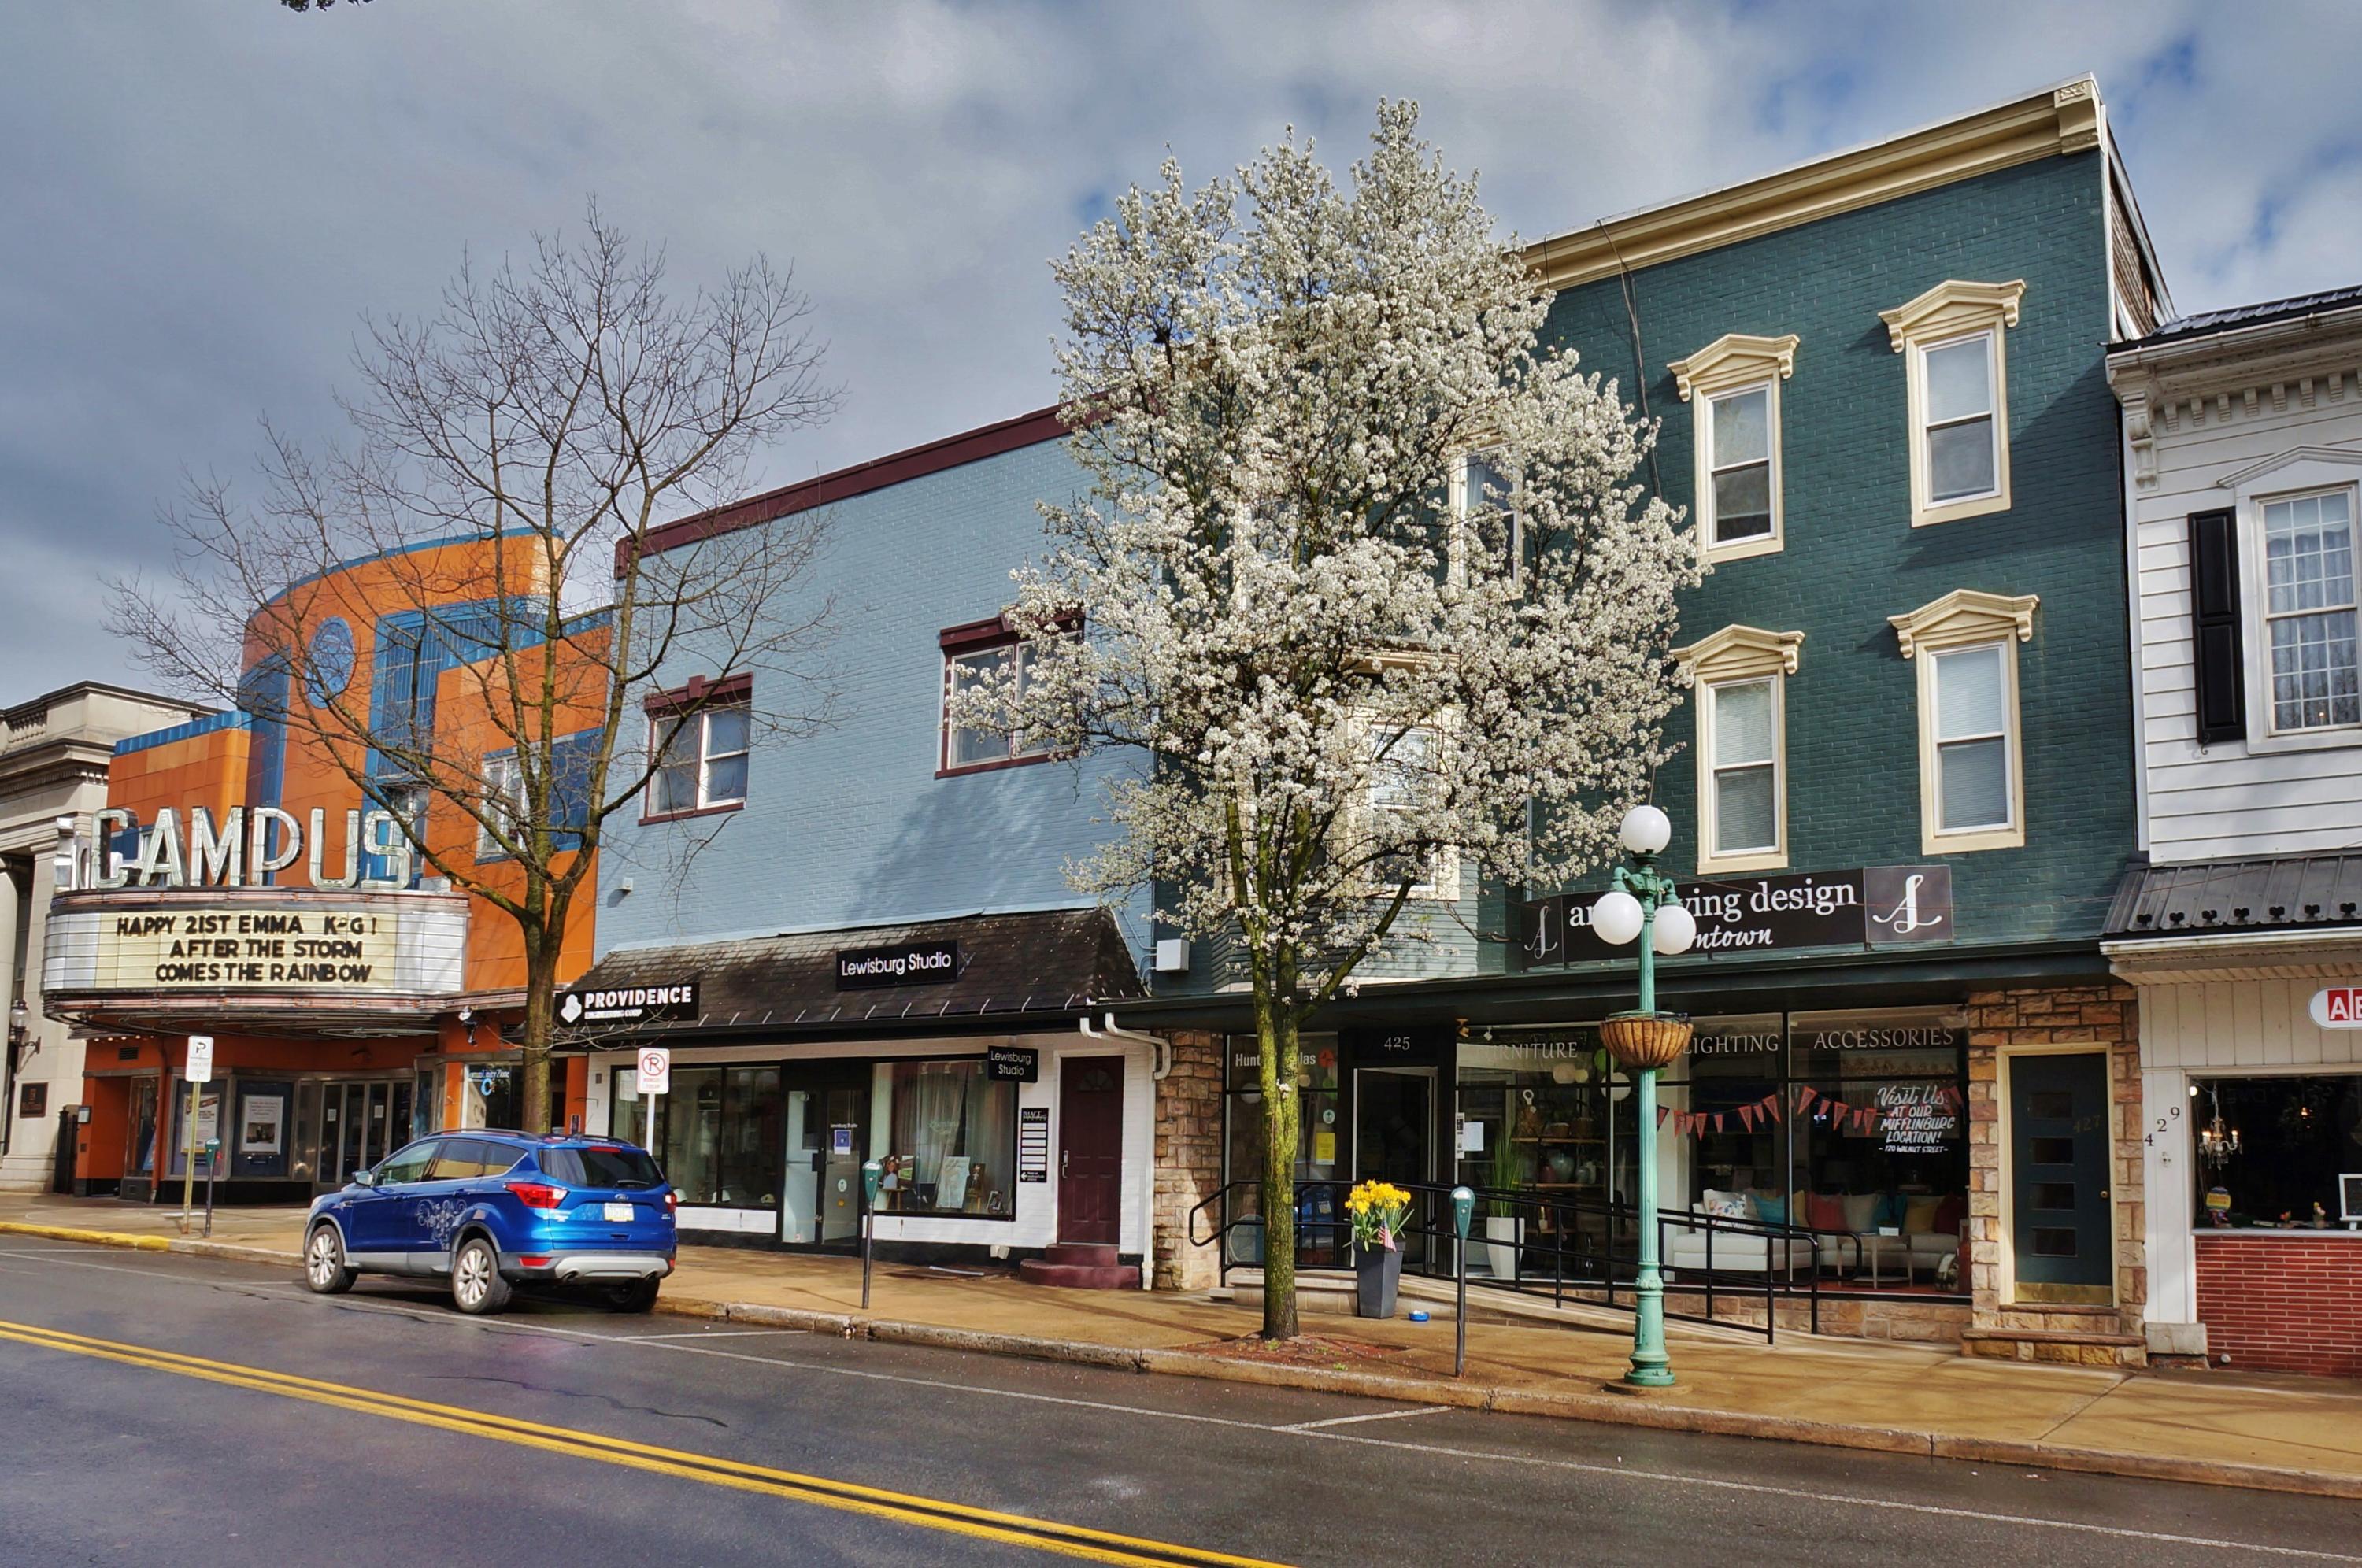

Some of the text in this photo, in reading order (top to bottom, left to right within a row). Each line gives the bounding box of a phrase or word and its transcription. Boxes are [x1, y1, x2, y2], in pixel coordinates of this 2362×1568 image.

[91, 806, 414, 889] CAMPUS
[1682, 878, 1857, 923] ving design
[117, 915, 177, 936] HAPPY
[238, 915, 304, 934] EMMA
[1693, 924, 1774, 949] ntown
[169, 939, 362, 959] AFTER THE STORM
[156, 963, 373, 982] COMES THE RAINBOW
[842, 951, 952, 976] Lewisburg Studio
[584, 986, 692, 1008] PROVIDENCE
[1383, 1037, 1411, 1051] 425
[1813, 1027, 1954, 1049] ACCESSORIES
[990, 1050, 1031, 1066] Lewisburg
[1235, 1053, 1261, 1067] Hunt
[998, 1063, 1024, 1076] Studio
[1877, 1085, 1944, 1107] Visit Us
[1890, 1105, 1933, 1118] AT OUR
[1879, 1116, 1956, 1132] MIFFLINBURG
[2144, 1106, 2180, 1147] 429
[1886, 1131, 1942, 1144] LOCATION!
